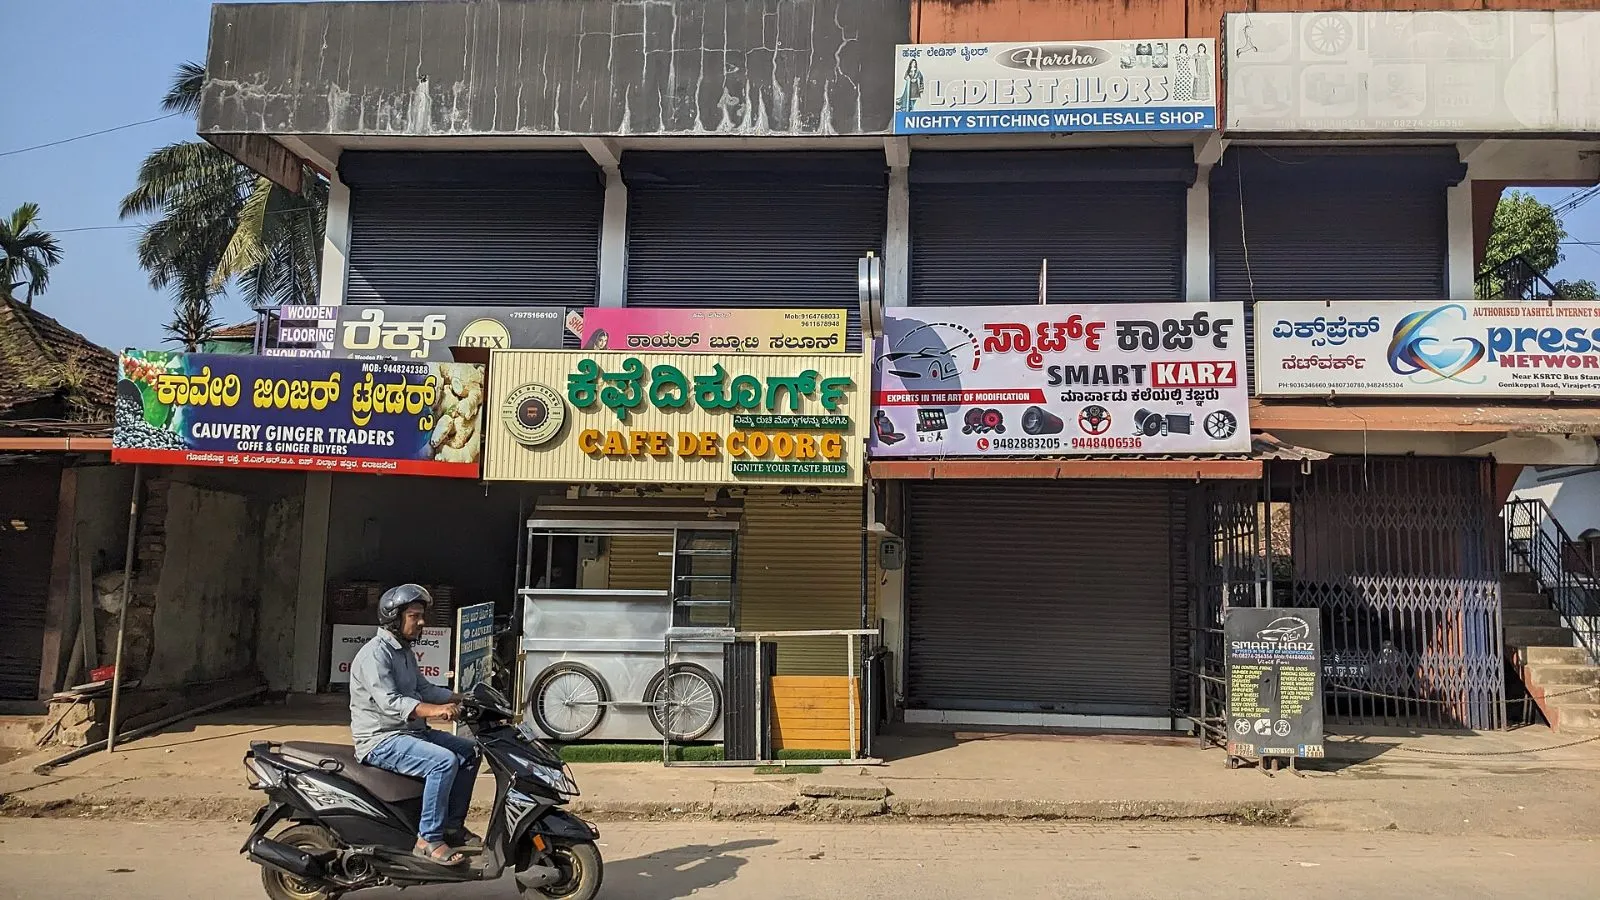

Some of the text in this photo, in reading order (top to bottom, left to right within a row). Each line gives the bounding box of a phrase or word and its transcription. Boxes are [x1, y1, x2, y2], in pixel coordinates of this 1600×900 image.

[902, 47, 922, 58] ಹರ್ಷ
[960, 46, 988, 61] ಟೈಲರ್
[1011, 47, 1097, 71] Harsha
[929, 76, 1169, 107] LADIES TAILORS
[905, 111, 1205, 129] NIGHTY STITCHING WHOLESALE SHOP
[288, 306, 333, 319] WOODEN
[1473, 307, 1520, 317] AUTHORISED
[1521, 308, 1554, 317] YASHTEL
[1556, 308, 1593, 317] INTERNET
[281, 328, 334, 341] FLOORING
[465, 335, 505, 348] REX
[628, 332, 700, 347] ರಾಯಲ್
[770, 333, 839, 348] ಸಲೂನ್
[983, 311, 1234, 369] ಸ್ಮಾರ್ಟ್ ಕಾರ್ಜ್
[1500, 354, 1600, 368] NETWOR
[362, 363, 428, 375] MOB: 9448242388
[1047, 362, 1233, 386] SMART KARZ
[157, 366, 241, 407] ಕಾವೇರಿ
[253, 371, 341, 411] ಜಿಂಜರ್
[887, 394, 919, 402] EXPERTS
[921, 394, 930, 402] IN
[932, 394, 946, 402] THE
[947, 393, 962, 402] ART
[975, 393, 1030, 401] MODIFICATION
[1131, 388, 1183, 406] ಕಲೆಯಲ್ಲಿ
[1185, 388, 1219, 407] ತಜ್ಞರು
[734, 415, 755, 427] ನಿಮ್ಮ
[756, 416, 773, 424] ರುಚಿ
[192, 422, 395, 446] CAUVERY GINGER TRADERS
[237, 441, 348, 455] COFFE & GINGER BUYERS
[578, 429, 842, 460] CAFE DE COORG
[993, 438, 1060, 449] 9482883205
[1072, 437, 1142, 449] 9448406536
[733, 463, 846, 473] IGNITE YOUR TASTE BUDS
[1231, 641, 1314, 650] SMART KARZ
